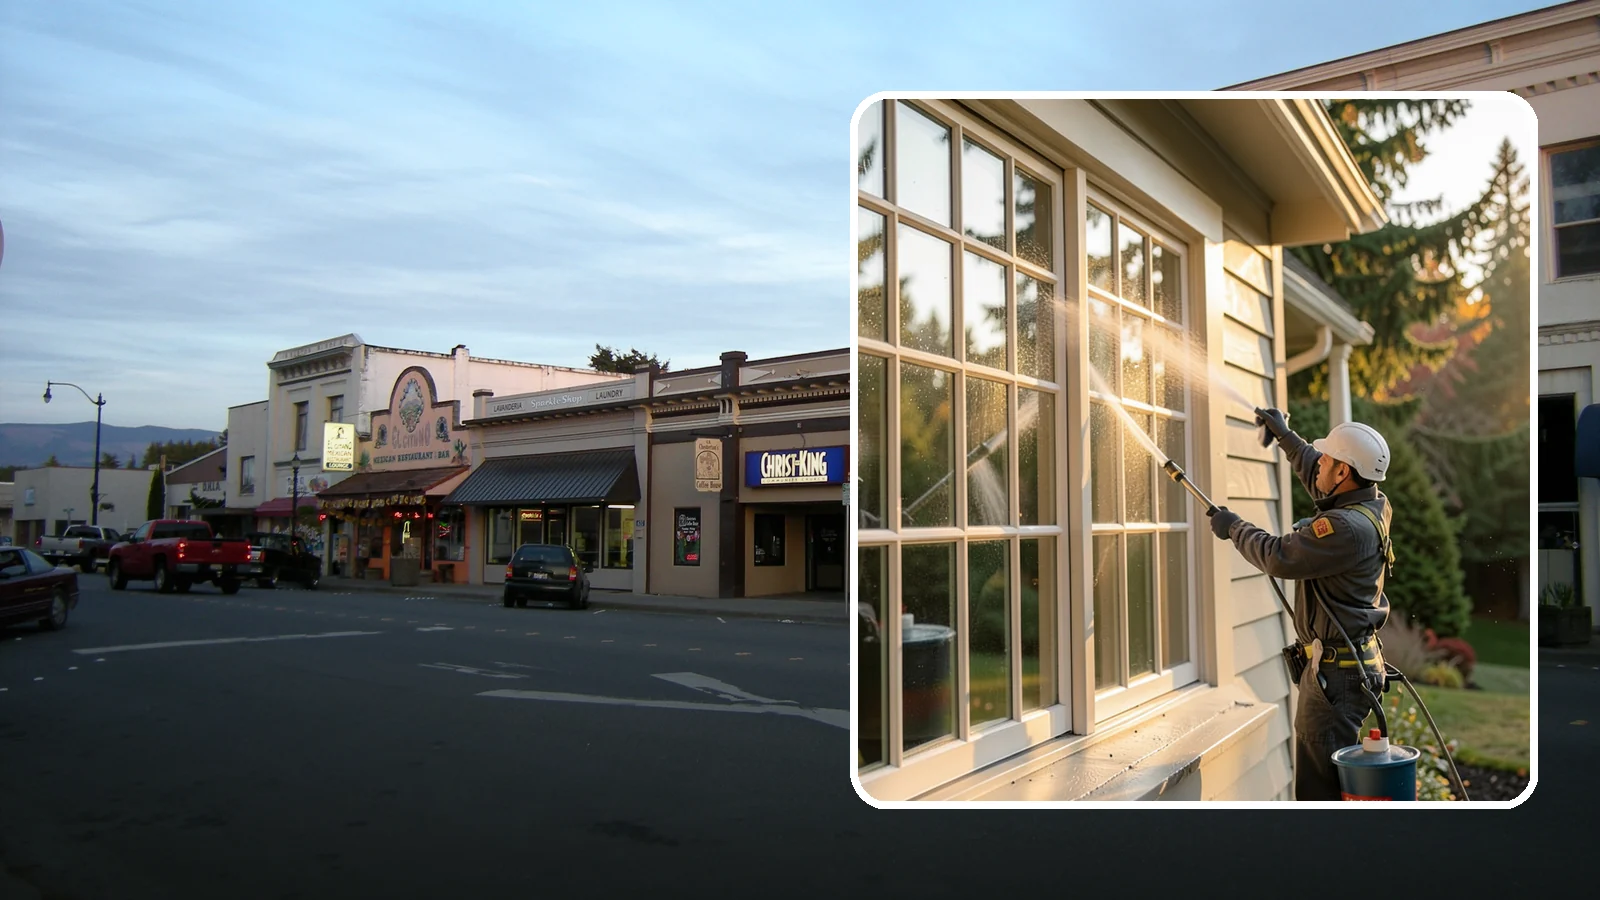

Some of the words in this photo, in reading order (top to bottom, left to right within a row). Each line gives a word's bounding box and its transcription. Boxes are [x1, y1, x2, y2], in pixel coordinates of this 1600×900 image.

[493, 402, 523, 413] LAVANDERIA
[530, 398, 561, 409] Sparkle
[561, 394, 583, 405] Shop
[595, 389, 624, 400] LAUNDRY
[374, 454, 396, 464] MEXICAN
[398, 451, 434, 462] RESTAURANT
[437, 450, 450, 459] BAR
[761, 452, 797, 478] CHRIST
[799, 450, 828, 476] KING
[696, 480, 709, 488] Coffee
